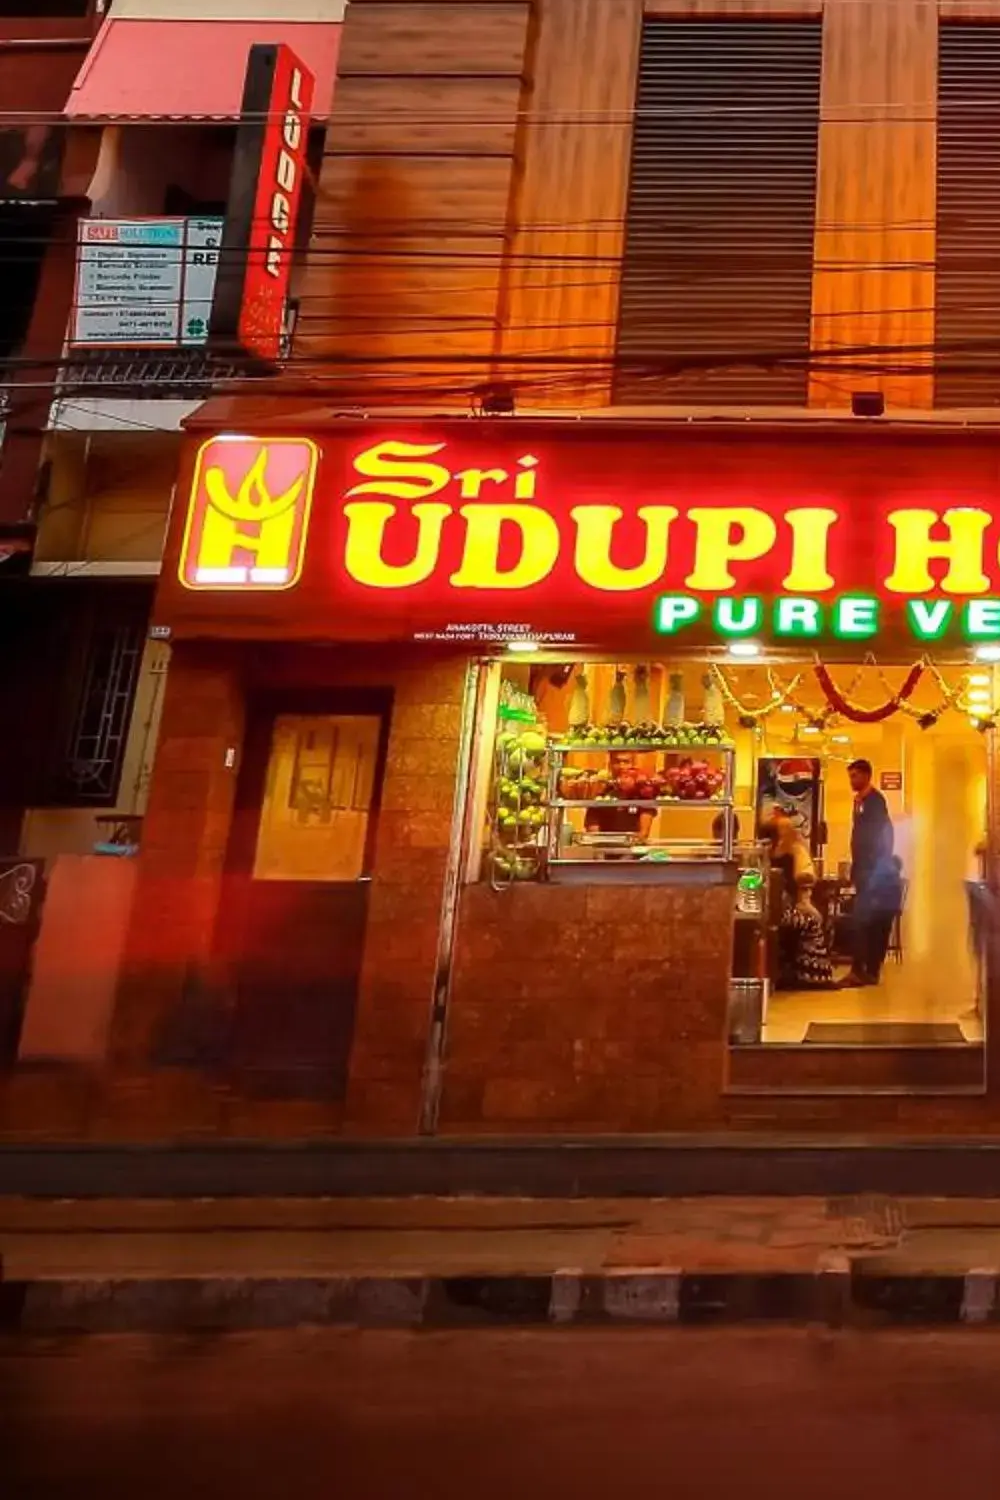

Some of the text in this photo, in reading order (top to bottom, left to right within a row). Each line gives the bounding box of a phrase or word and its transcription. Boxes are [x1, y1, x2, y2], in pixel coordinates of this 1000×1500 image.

[266, 68, 303, 278] LODGE
[342, 440, 539, 499] Sri
[342, 502, 837, 591] UDUPI
[497, 624, 531, 632] STREET
[658, 596, 878, 635] PURE
